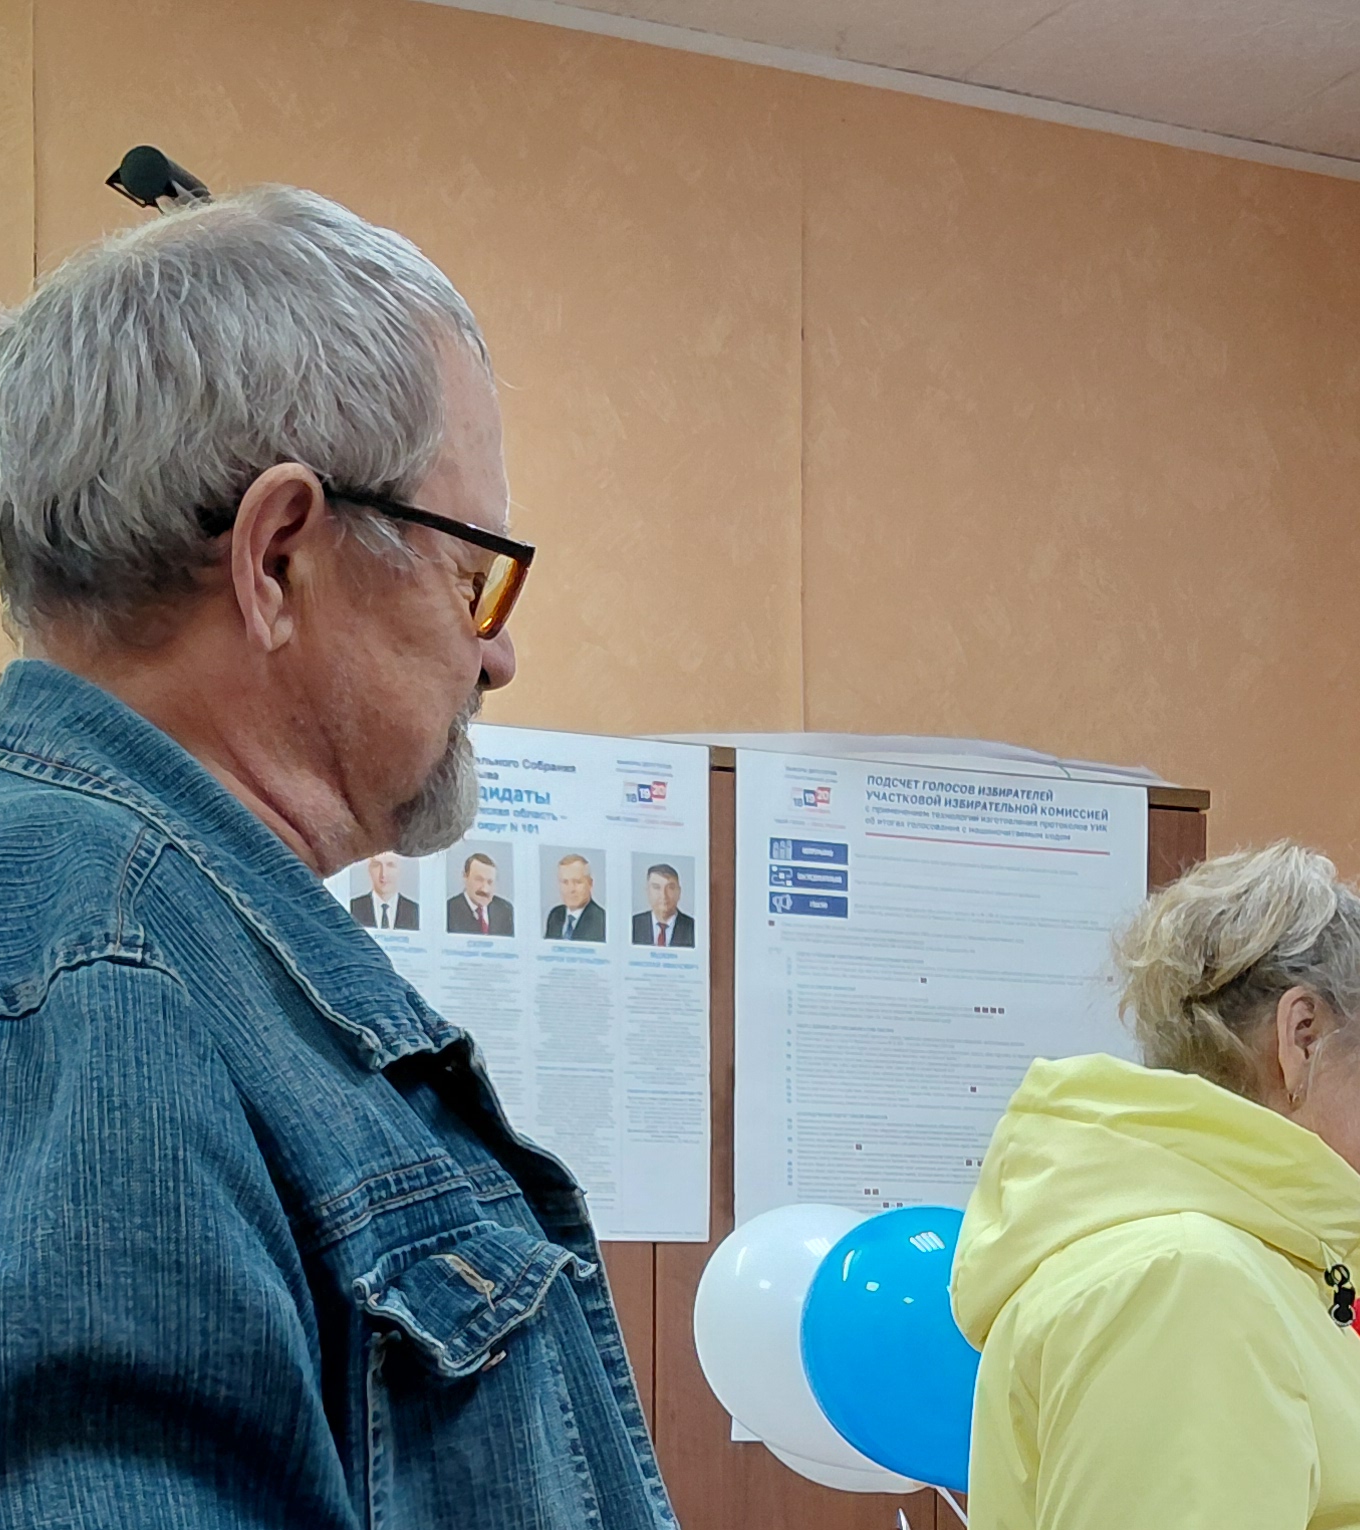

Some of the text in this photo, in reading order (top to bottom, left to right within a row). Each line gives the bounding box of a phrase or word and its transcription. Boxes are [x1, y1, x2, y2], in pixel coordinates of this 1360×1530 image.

[522, 759, 576, 773] Собрания
[478, 786, 551, 805] дидаты
[867, 775, 1054, 802] ПОДСЧЕТ ГОЛОСОВ ИЗБИРАТЕЛЕЙ
[866, 790, 1108, 821] УЧАСТКОВОЙ ИЗБИРАТЕЛЬНОЙ КОМИССИЕЙ
